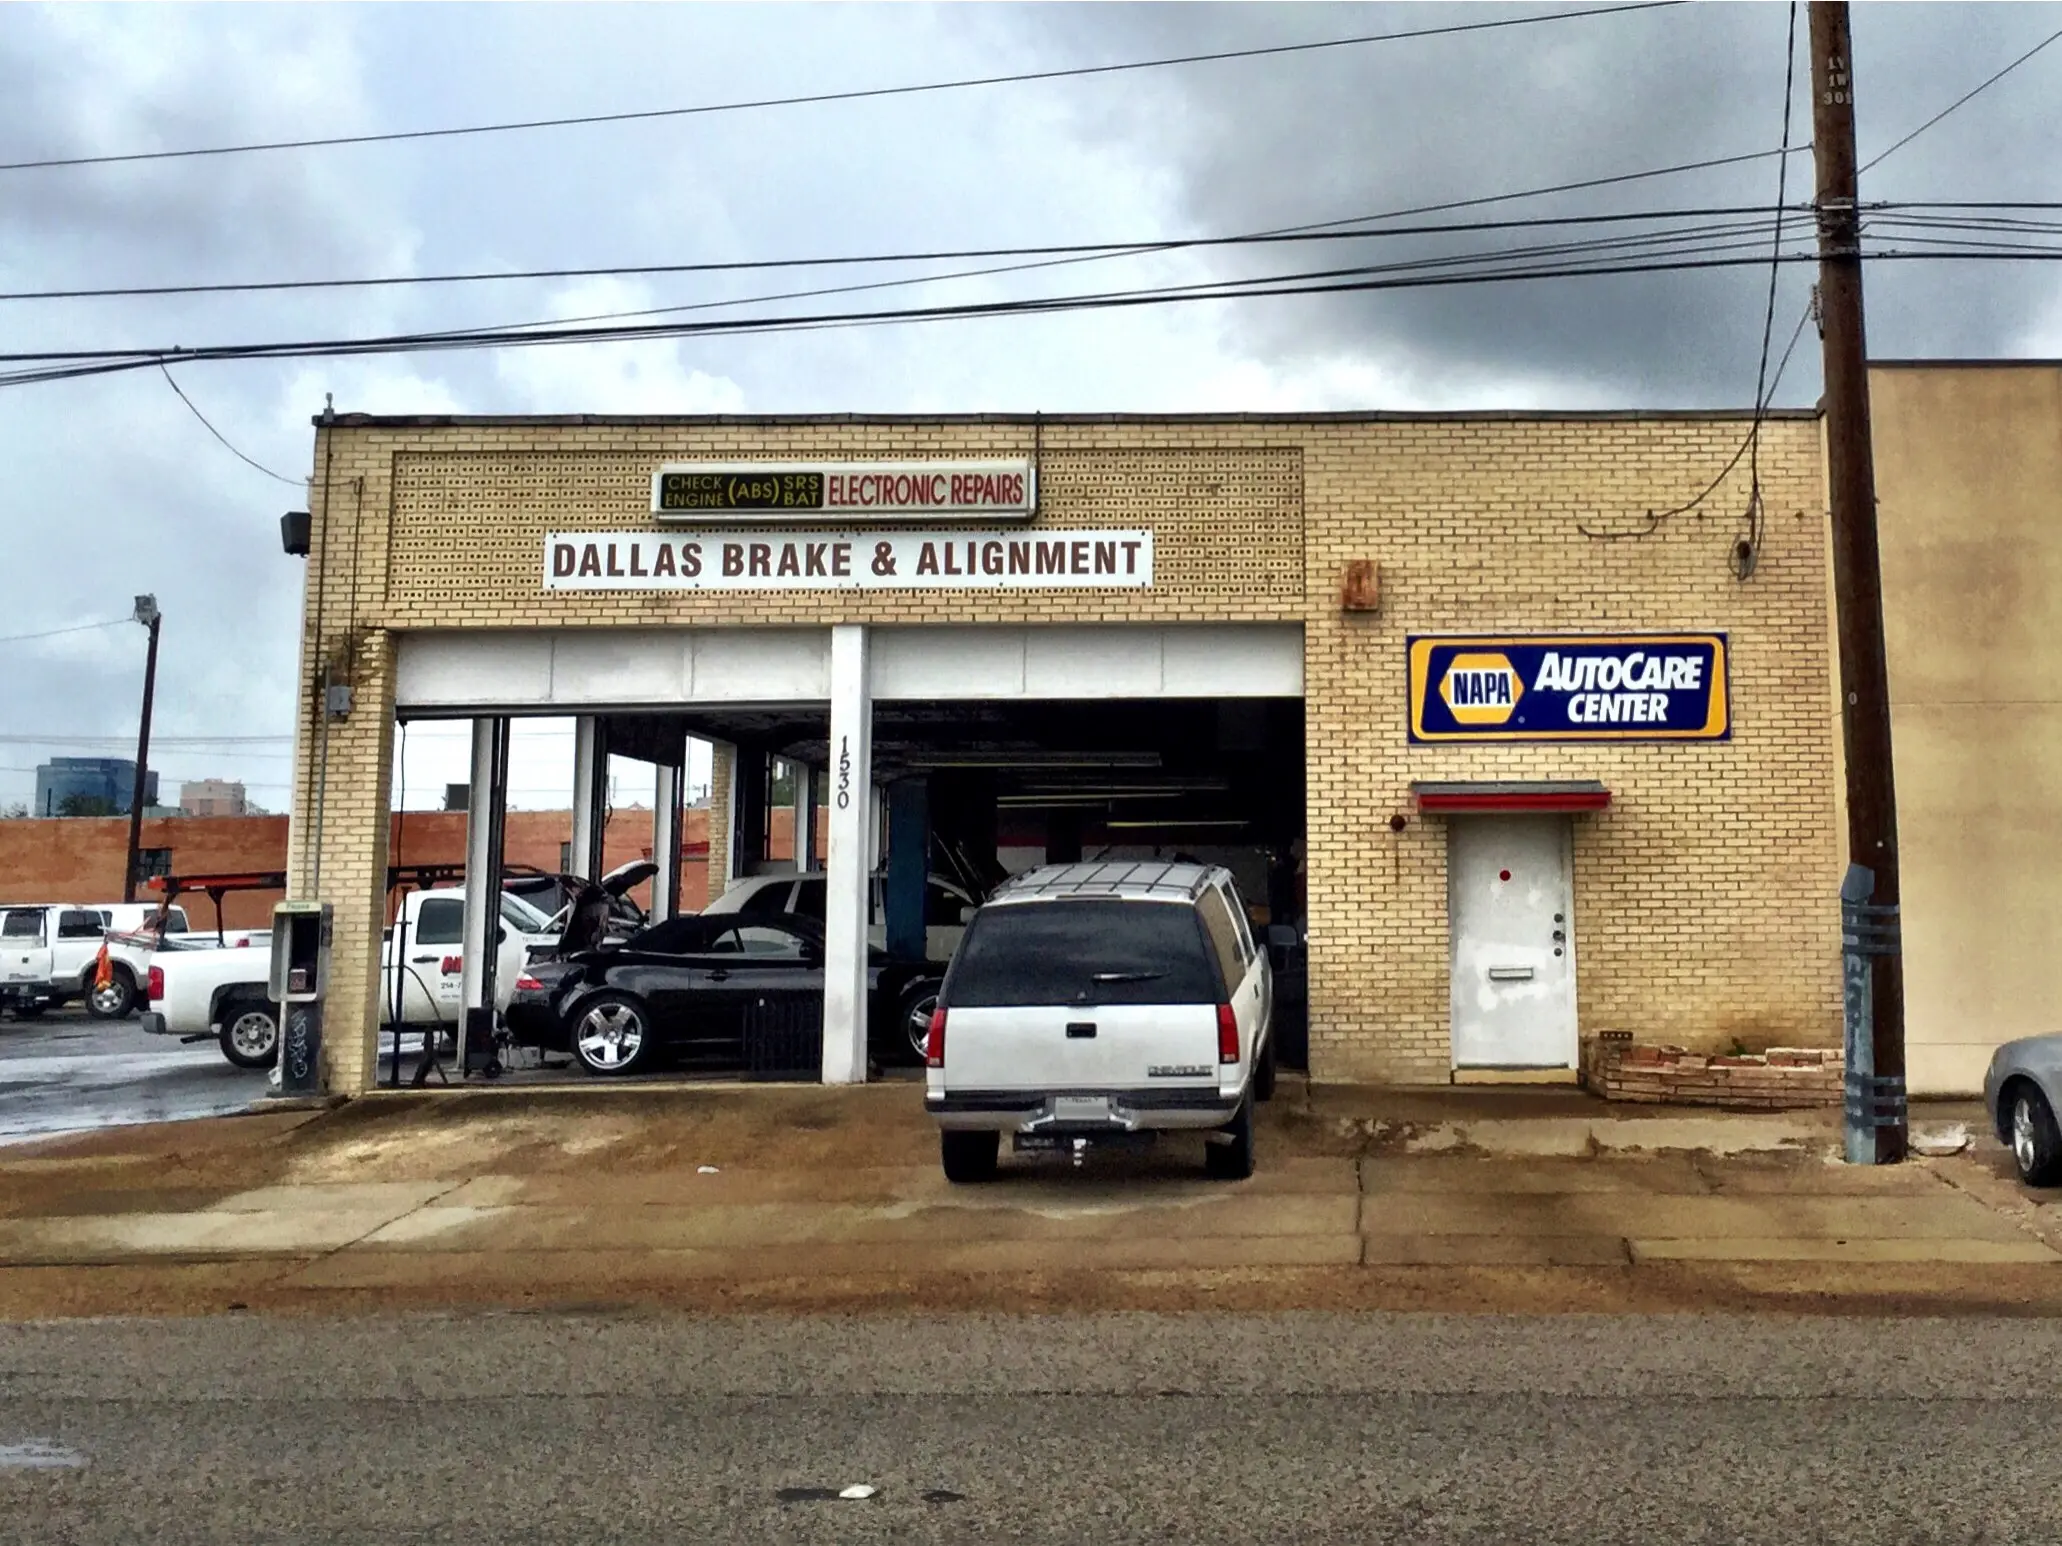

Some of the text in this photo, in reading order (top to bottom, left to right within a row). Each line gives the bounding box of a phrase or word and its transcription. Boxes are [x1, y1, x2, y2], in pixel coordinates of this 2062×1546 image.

[668, 476, 722, 490] CHECK
[728, 477, 779, 505] (ABS)
[784, 476, 819, 490] SRS
[828, 473, 1024, 506] ELECTRONIC REPAIRS
[665, 493, 724, 507] ENGINE
[784, 492, 818, 506] BAT
[552, 541, 1142, 577] DALLAS BRAKE & ALIGNMENT
[1453, 672, 1511, 705] NAPA
[1567, 693, 1669, 723] CENTER
[837, 735, 851, 810] 1530
